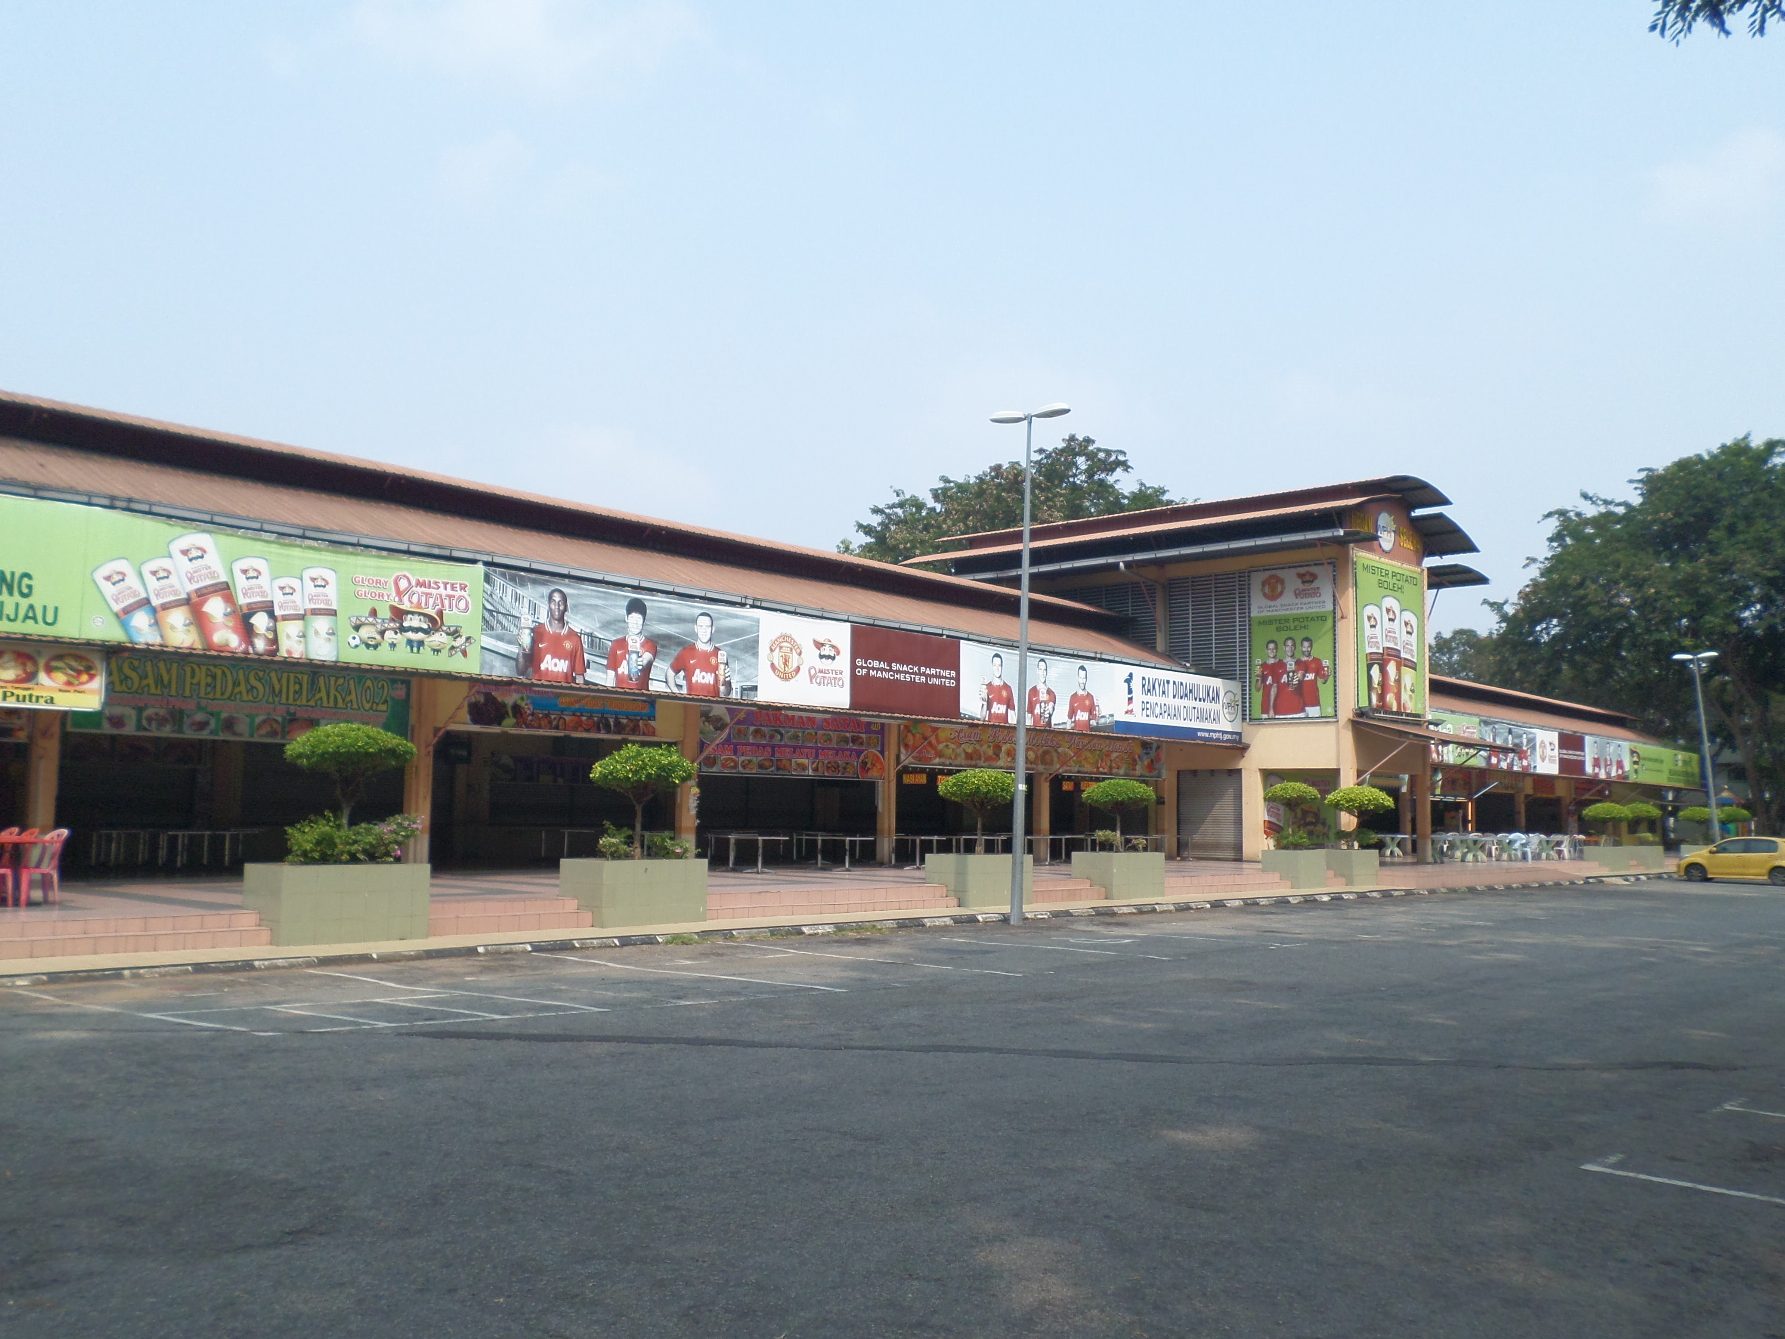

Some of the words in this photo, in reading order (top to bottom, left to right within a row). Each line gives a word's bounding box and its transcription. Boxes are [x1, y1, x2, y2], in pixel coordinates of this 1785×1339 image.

[352, 575, 389, 588] GLORY
[1362, 563, 1390, 580] MISTER
[1391, 570, 1418, 587] POTATO
[391, 573, 471, 614] POTATO
[414, 578, 469, 593] MISTER
[1377, 578, 1405, 594] BOLEH!
[355, 589, 393, 601] GLORY
[1292, 615, 1327, 624] POTATO
[540, 654, 569, 673] AON
[818, 668, 844, 676] MISTER
[855, 658, 890, 669] GLOBAL
[891, 662, 919, 673] SNACK
[920, 666, 956, 678] PARTNER
[691, 668, 716, 685] AON
[775, 669, 796, 679] UNITED
[808, 666, 845, 688] POTATO
[869, 669, 926, 684] MANCHESTER
[928, 677, 956, 687] UNITED
[107, 656, 178, 696] ASAM
[183, 659, 268, 702] PEDAS
[269, 669, 359, 711] MELAKA
[1141, 676, 1171, 697] RAKYAT
[1172, 679, 1221, 705] DIDAHULUKAN
[1, 689, 55, 705] Putra
[1141, 700, 1182, 720] PENCAPAIAN
[1182, 705, 1221, 725] DIUTAMAKAN
